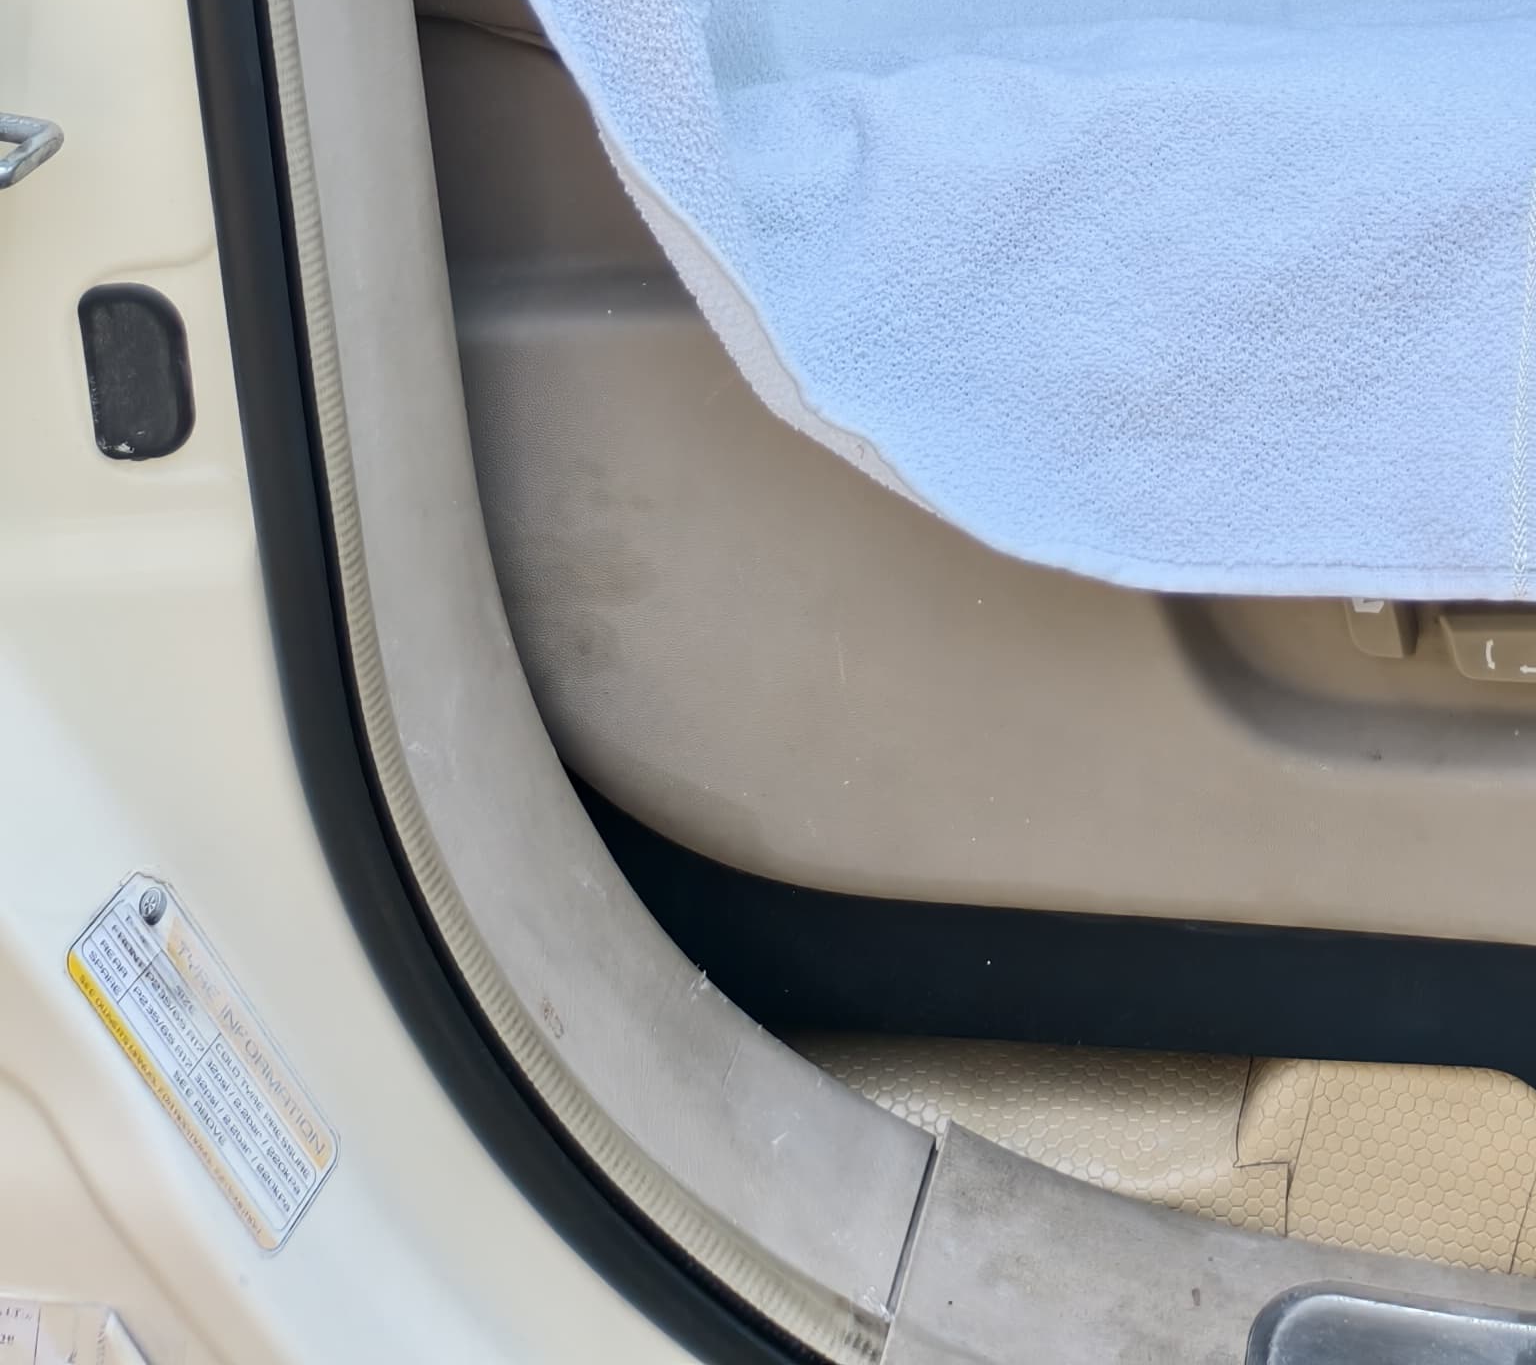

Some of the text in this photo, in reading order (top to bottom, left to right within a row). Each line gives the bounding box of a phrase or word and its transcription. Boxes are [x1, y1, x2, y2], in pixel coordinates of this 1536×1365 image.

[88, 950, 121, 997] SPARE
[99, 939, 129, 979] REAR
[215, 1043, 241, 1078] COLD
[240, 1080, 265, 1112] TYRE
[263, 1112, 311, 1180] PRESSURE
[220, 1005, 326, 1156] INFORMATION
